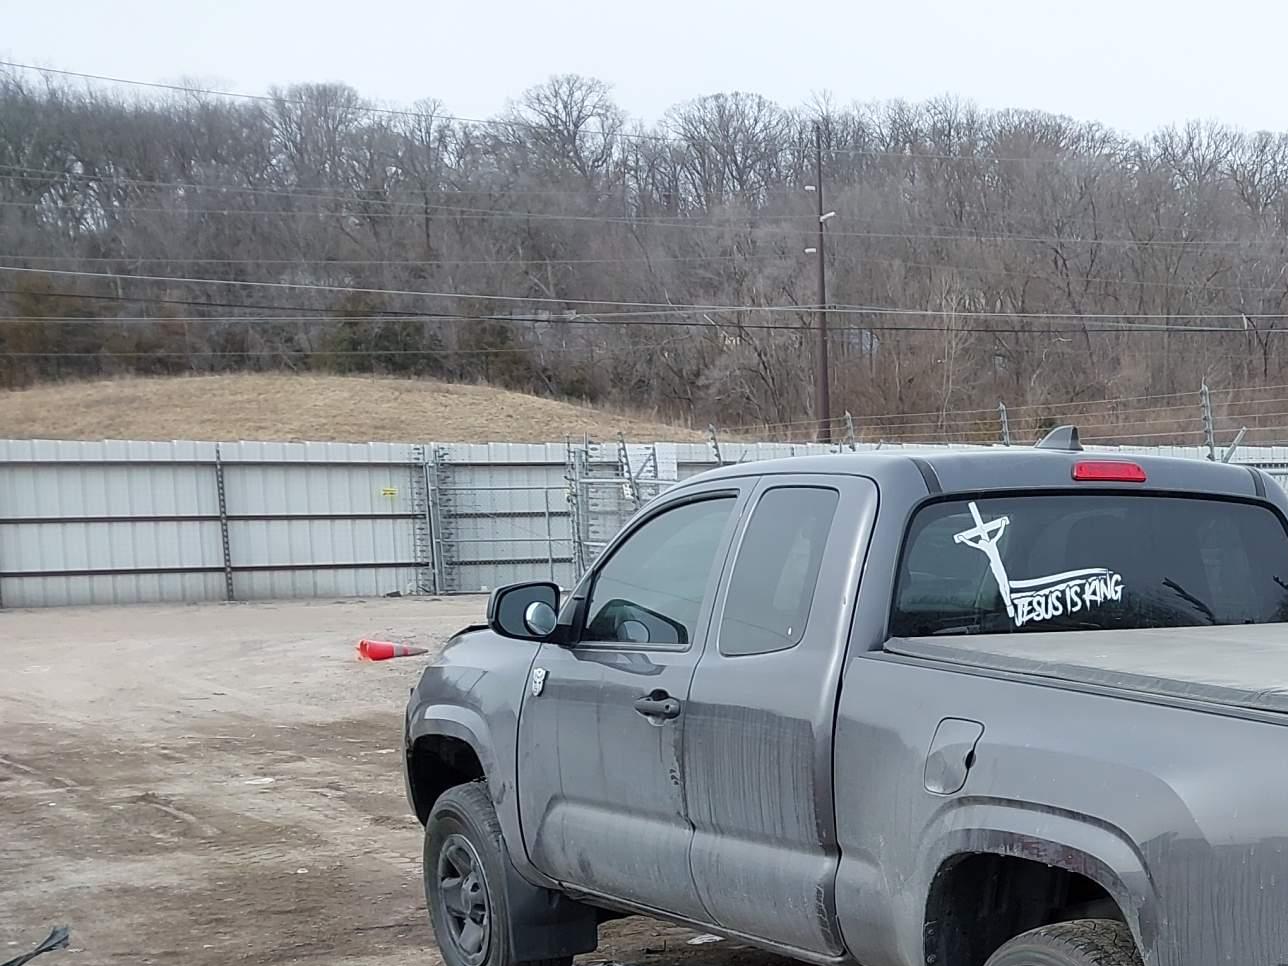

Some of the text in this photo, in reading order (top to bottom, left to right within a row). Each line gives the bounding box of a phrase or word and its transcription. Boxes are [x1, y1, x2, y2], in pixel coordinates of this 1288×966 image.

[1013, 570, 1125, 627] JESUS IS KING
